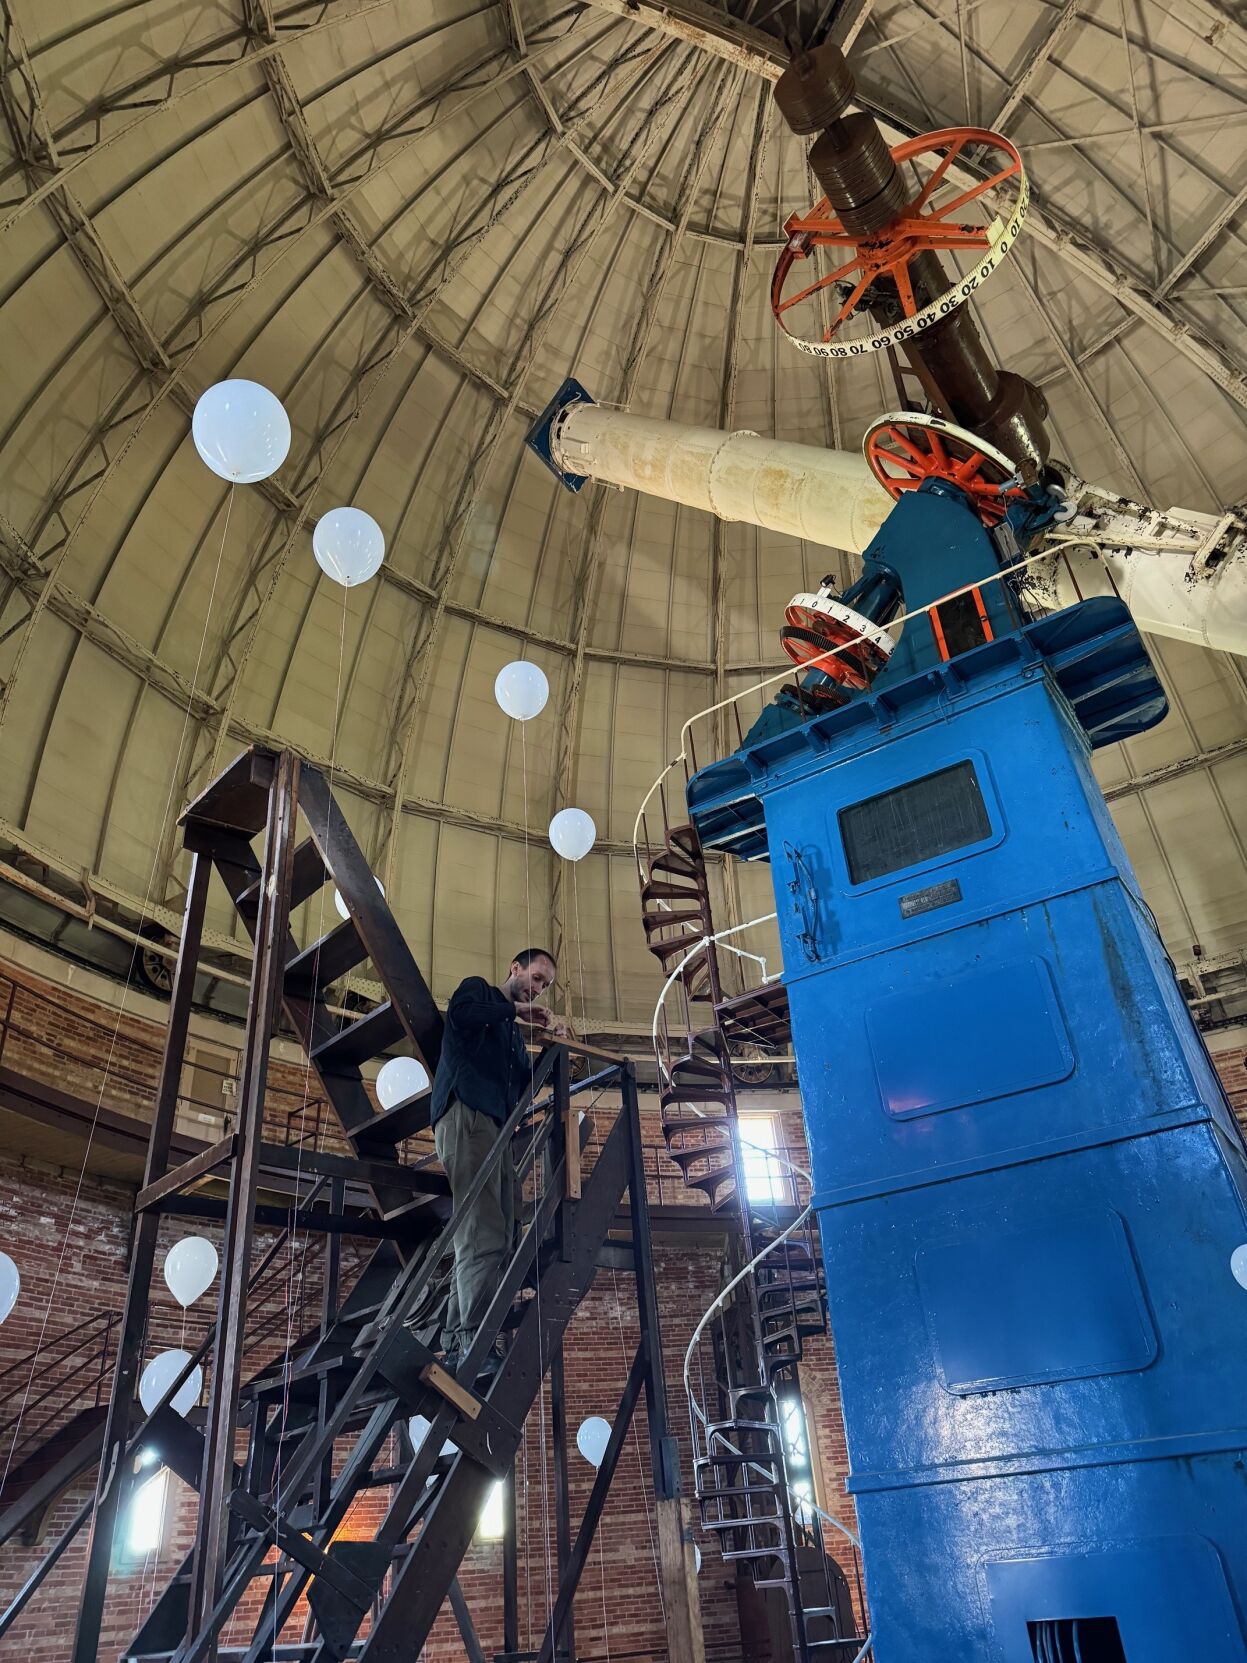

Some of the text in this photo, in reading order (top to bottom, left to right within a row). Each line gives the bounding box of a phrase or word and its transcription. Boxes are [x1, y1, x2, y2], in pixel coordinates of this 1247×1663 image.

[1019, 197, 1027, 218] 20
[1010, 218, 1020, 238] 10
[1000, 241, 1008, 254] 0
[980, 258, 995, 278] 10
[961, 276, 979, 297] 20
[939, 295, 959, 314] 30
[916, 311, 937, 329] 40
[871, 336, 891, 349] 60
[894, 326, 915, 341] 50
[813, 347, 829, 357] 90
[830, 347, 848, 357] 80
[849, 344, 868, 355] 70
[827, 606, 833, 614] 1
[842, 615, 850, 623] 2
[859, 624, 867, 633] 3
[874, 636, 882, 644] 4
[888, 647, 895, 656] 5
